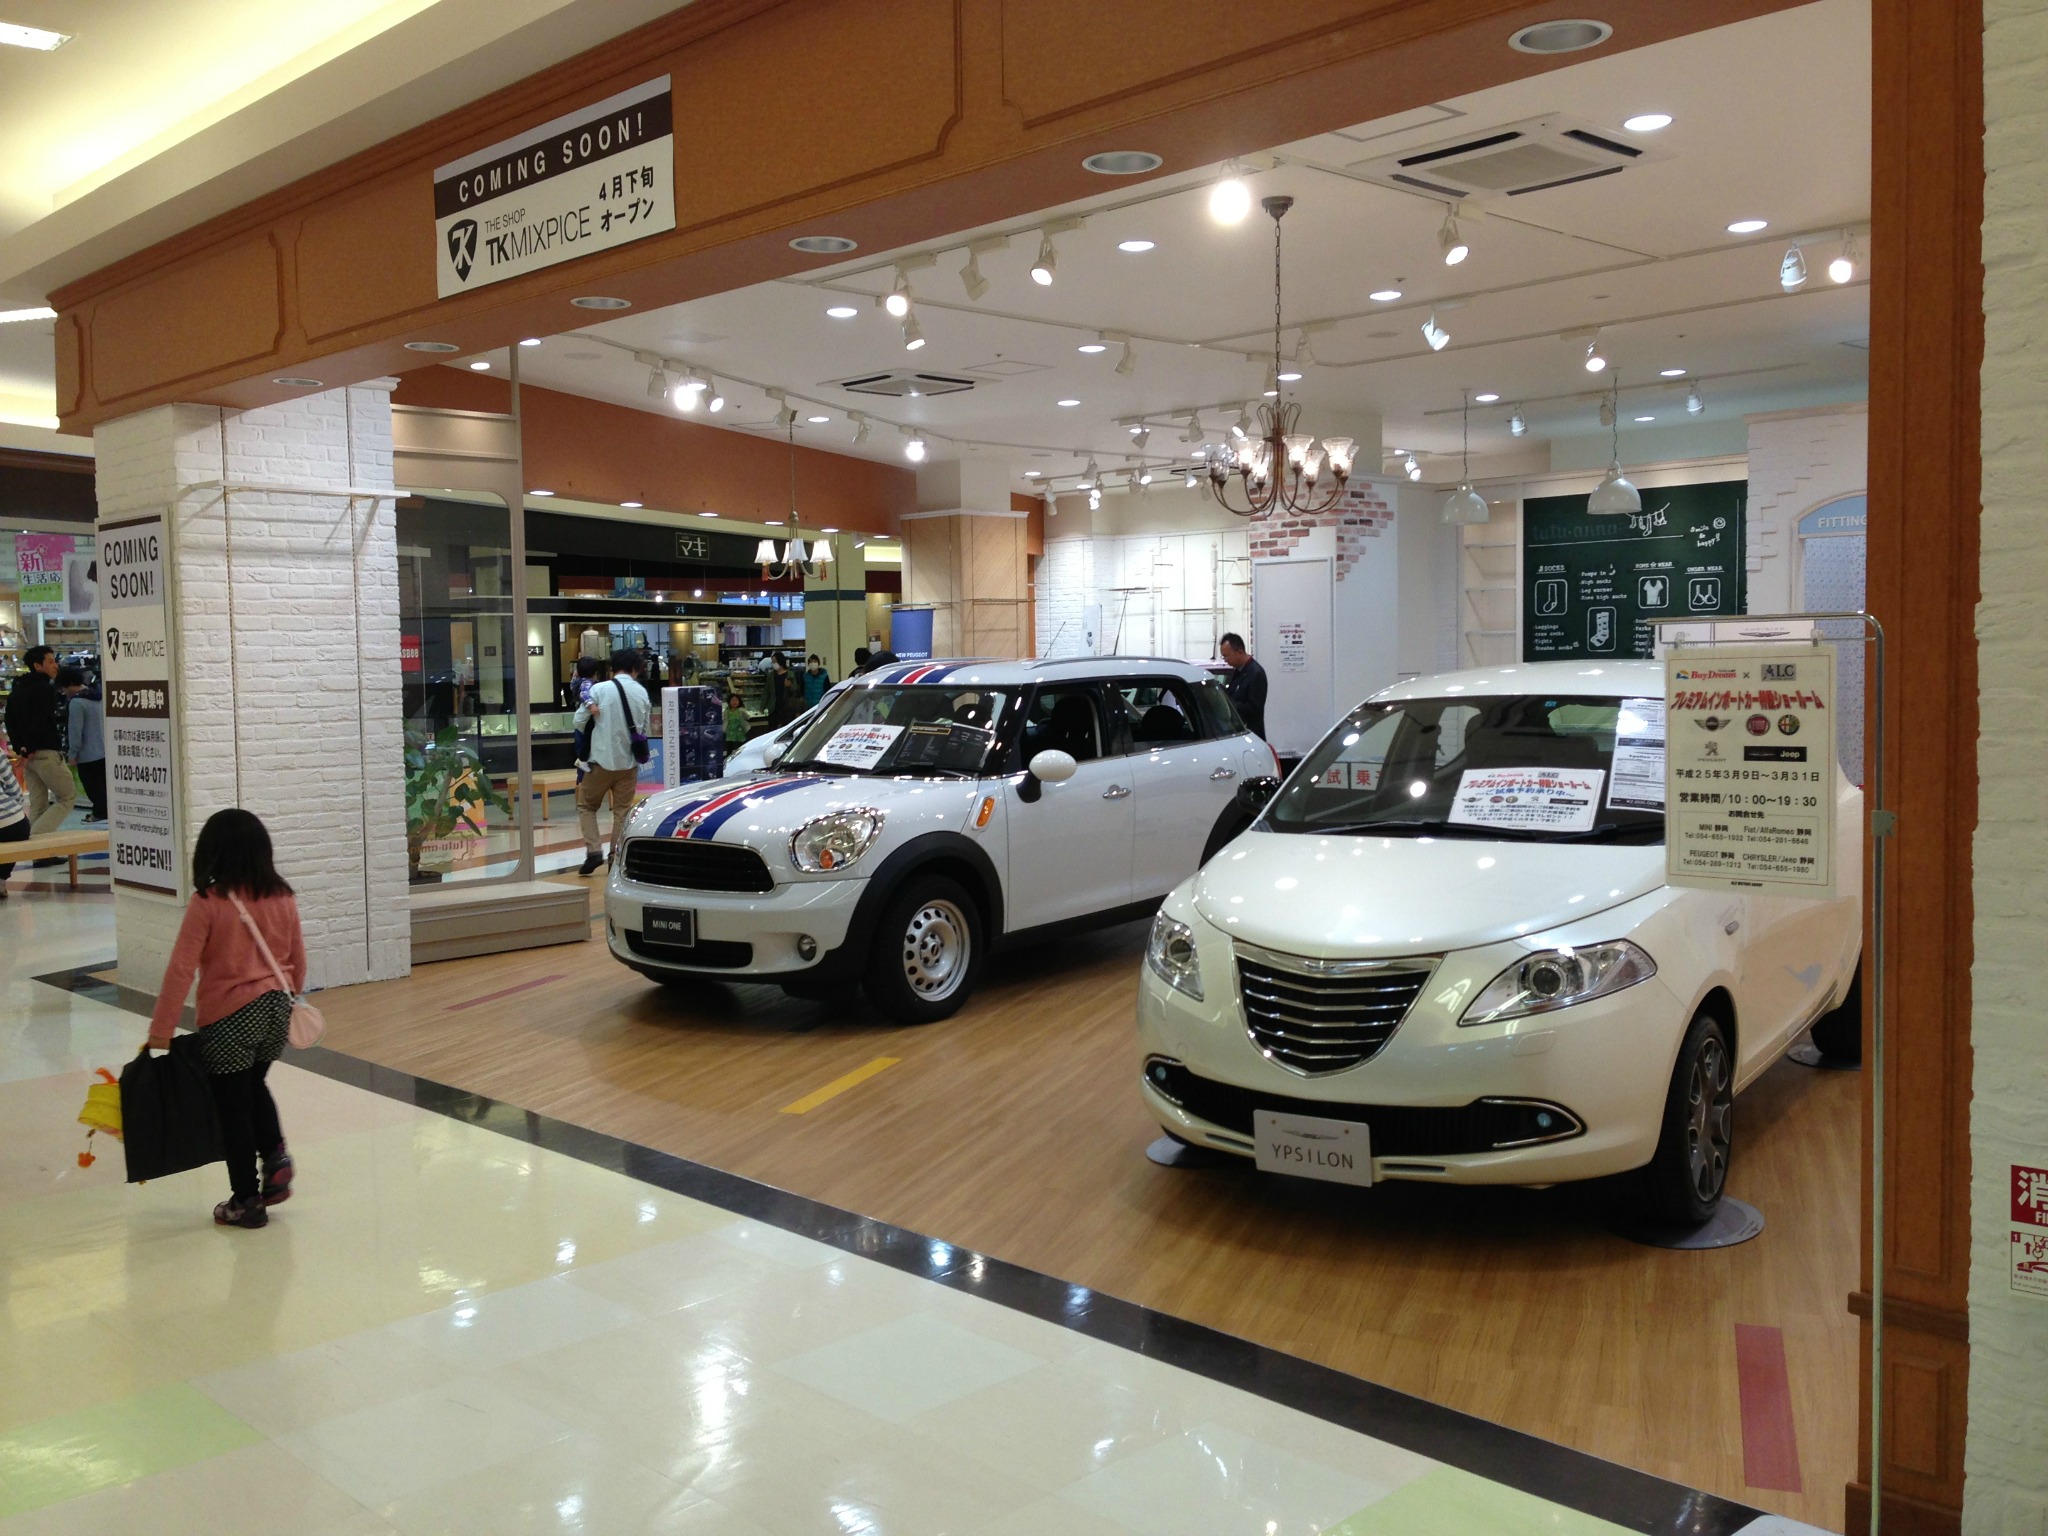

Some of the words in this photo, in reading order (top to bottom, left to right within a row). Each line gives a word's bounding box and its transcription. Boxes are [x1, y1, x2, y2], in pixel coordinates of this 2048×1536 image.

[459, 151, 546, 203] COMING
[562, 112, 643, 164] SOON!
[598, 165, 654, 201] 4月下旬
[485, 214, 501, 234] THE
[502, 208, 526, 228] SHOP
[600, 197, 655, 232] オープン
[485, 206, 591, 266] TKMIXPICE
[104, 535, 158, 567] COMING
[679, 537, 707, 557] マキ
[20, 551, 41, 572] 新
[110, 570, 154, 599] SOON!
[111, 688, 164, 709] スタッフ募集中
[668, 701, 676, 788] RE-GENERATIO
[1780, 750, 1800, 759] Jeep
[114, 764, 167, 784] 0120-048-077
[117, 843, 172, 872] 近日OPEN!!
[1689, 850, 1718, 858] PEUGEOT
[1742, 853, 1797, 864] CHRYSLER/Jeep
[653, 920, 668, 929] MINI
[669, 921, 682, 931] ONE
[1272, 1143, 1354, 1169] YPSILON
